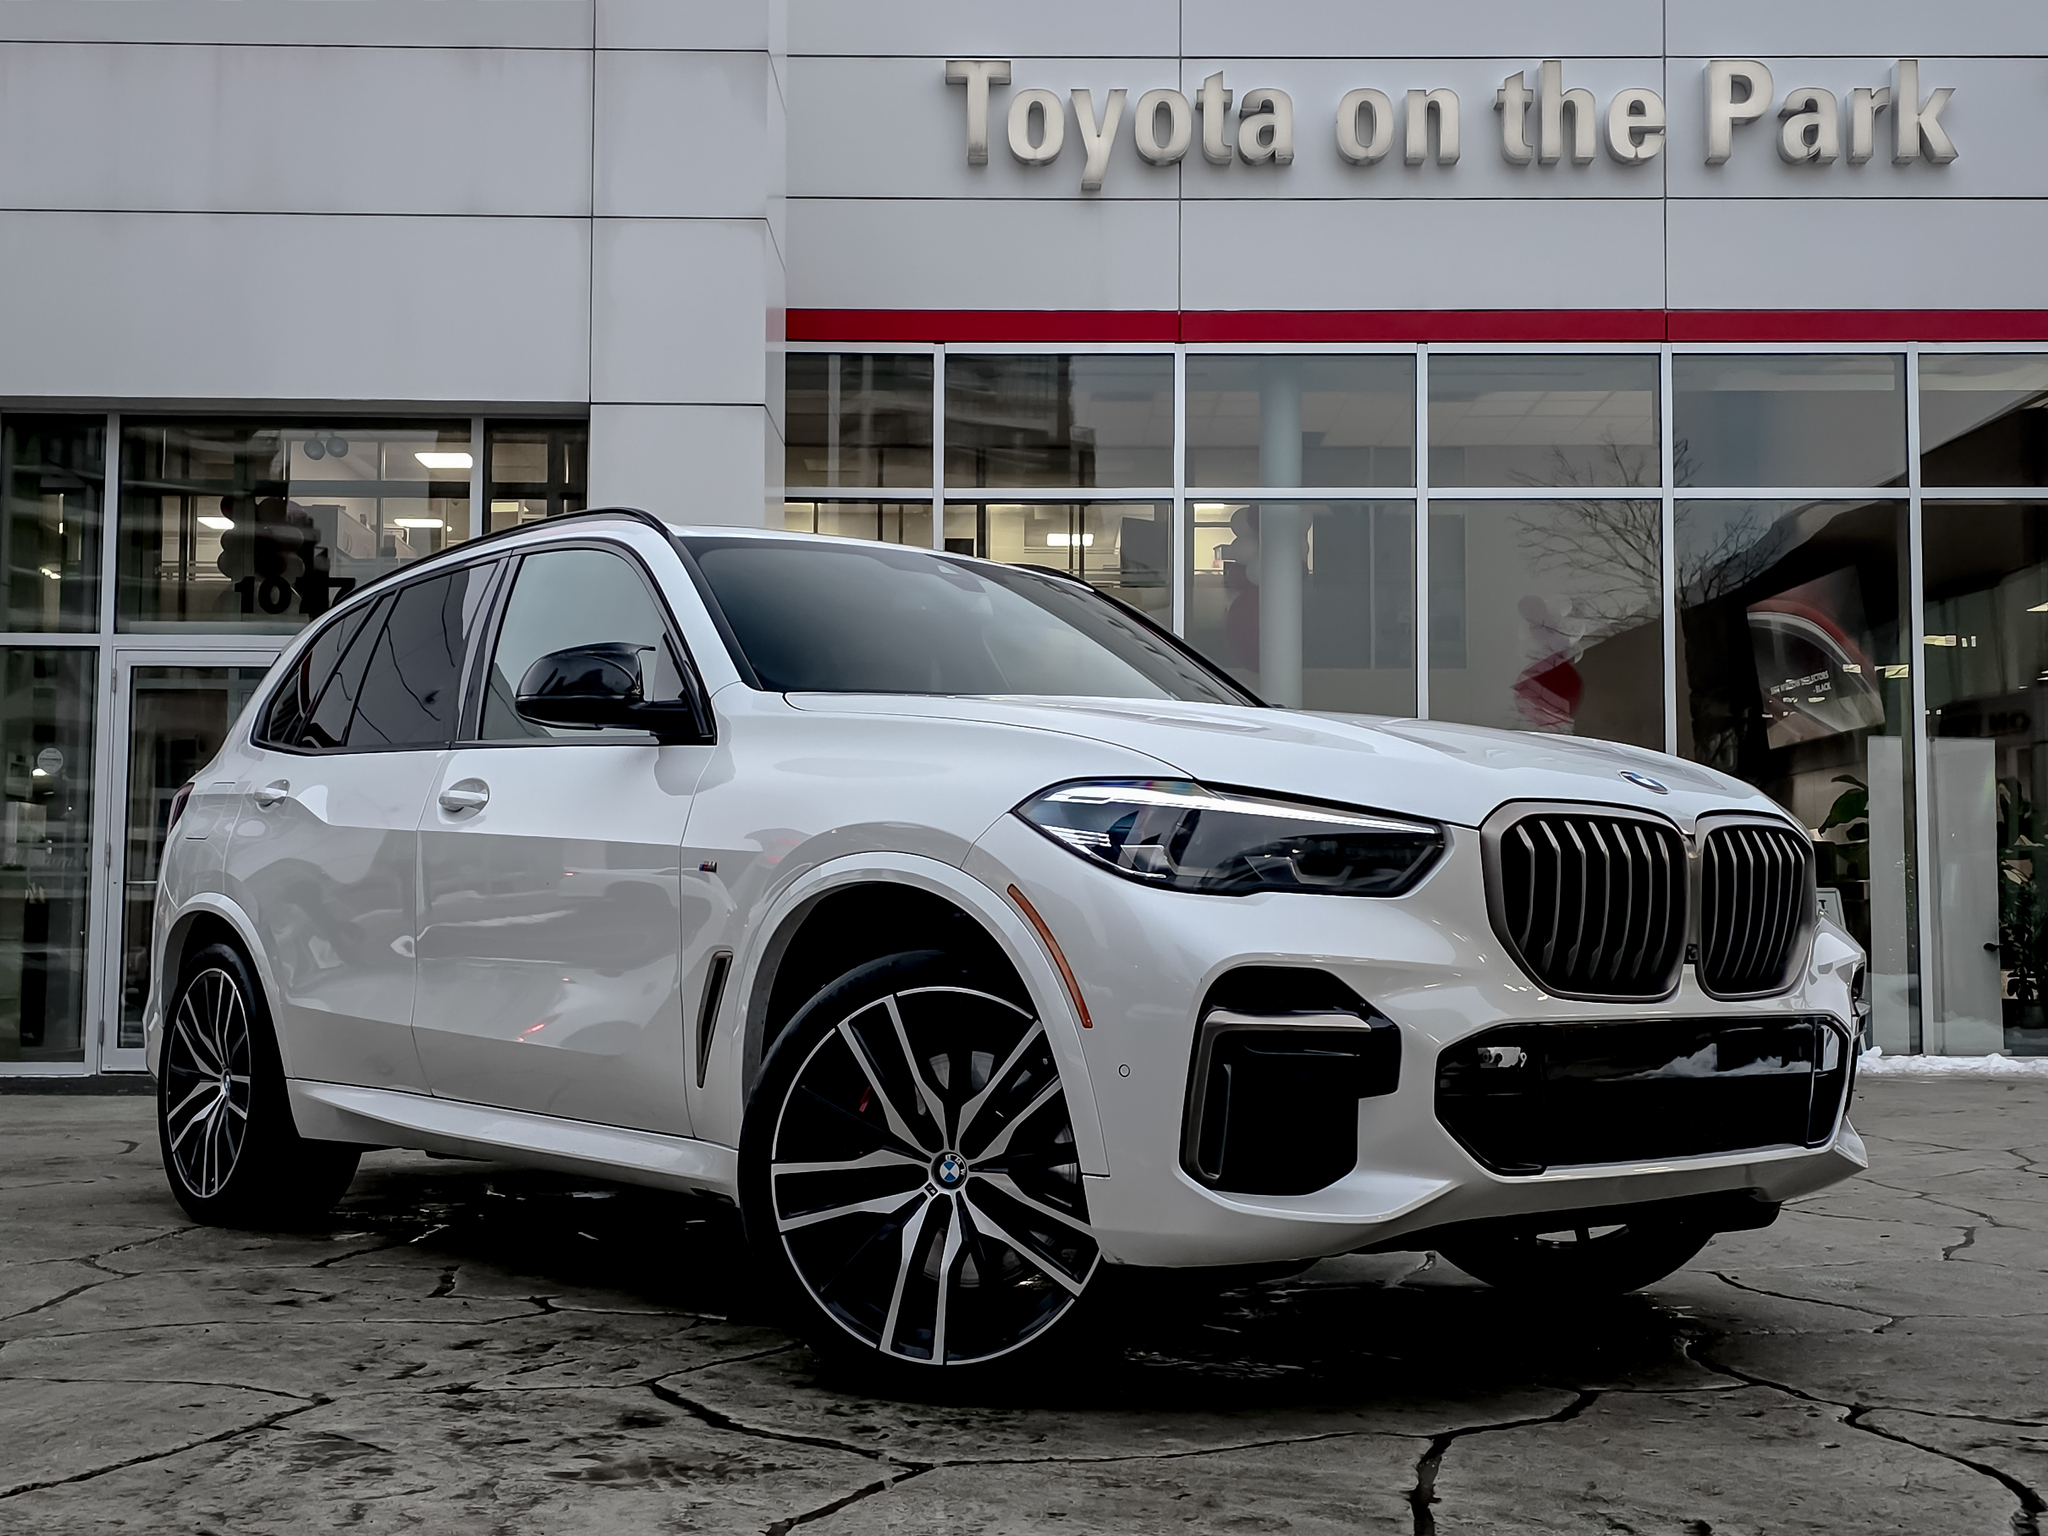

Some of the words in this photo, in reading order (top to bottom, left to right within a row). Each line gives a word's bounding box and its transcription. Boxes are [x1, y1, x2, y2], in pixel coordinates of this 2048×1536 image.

[945, 60, 1295, 191] Toyota
[1336, 87, 1461, 166] on
[1493, 60, 1666, 166] the
[1703, 59, 1960, 166] Park
